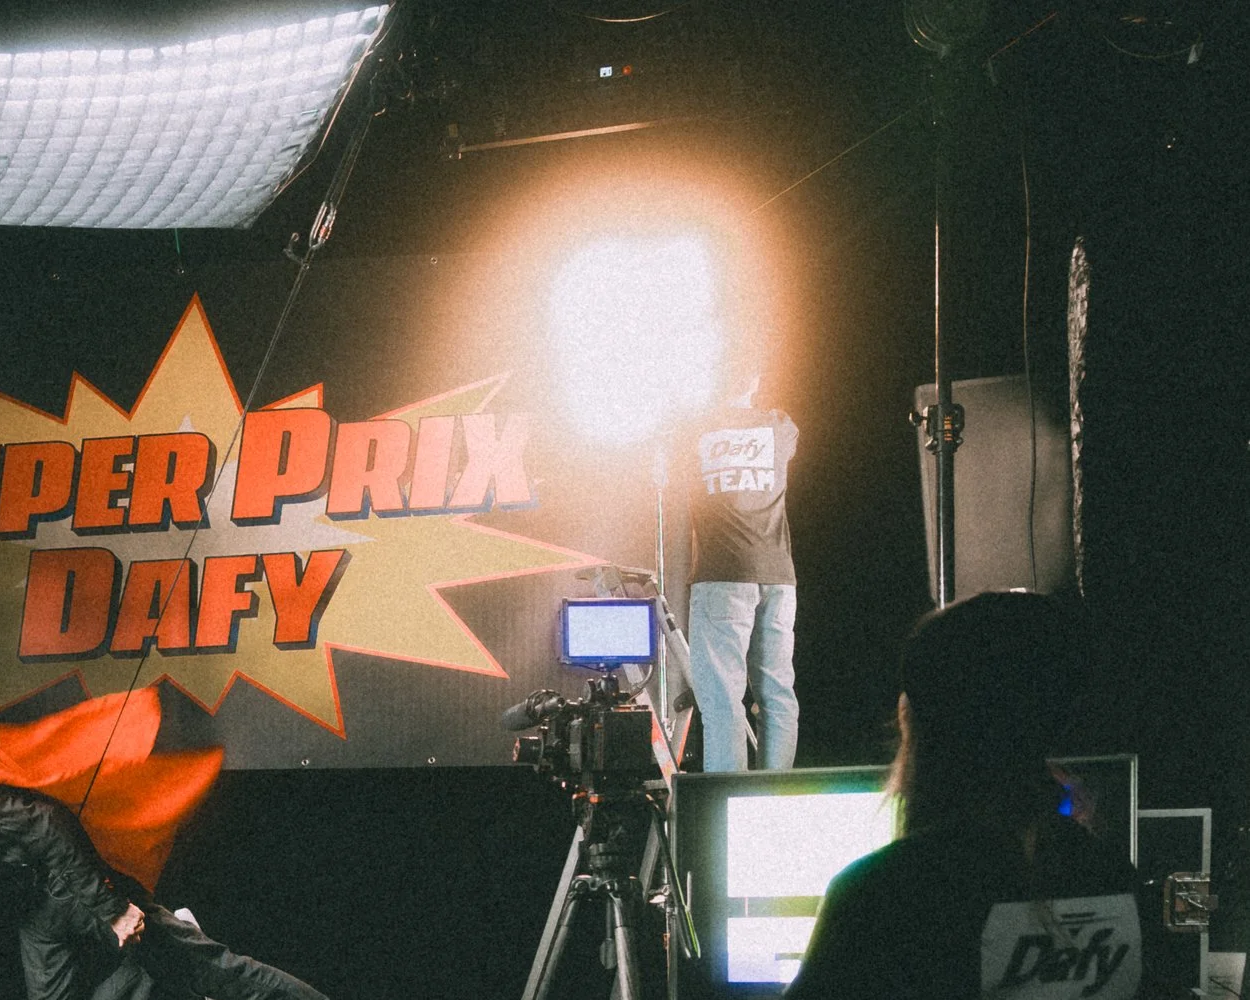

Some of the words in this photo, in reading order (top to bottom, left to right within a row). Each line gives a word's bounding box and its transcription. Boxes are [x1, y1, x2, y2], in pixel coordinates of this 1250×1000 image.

[231, 408, 539, 525] PRIX
[703, 470, 775, 495] TEAM
[711, 440, 766, 461] Dafy
[19, 548, 352, 662] DAFY
[996, 927, 1130, 998] Dafy
